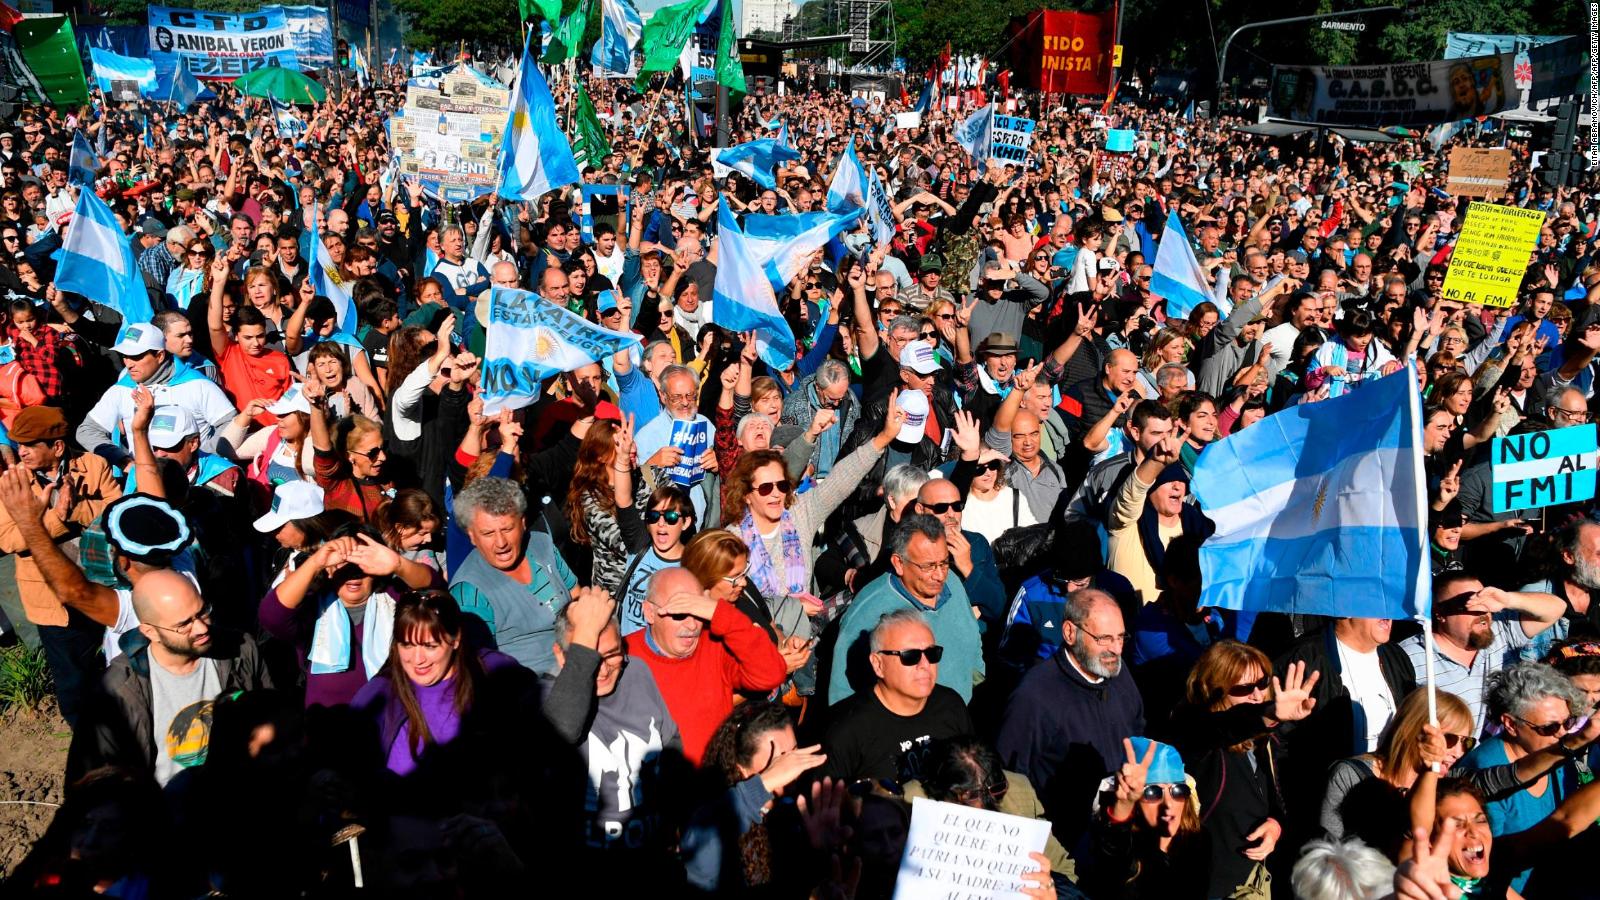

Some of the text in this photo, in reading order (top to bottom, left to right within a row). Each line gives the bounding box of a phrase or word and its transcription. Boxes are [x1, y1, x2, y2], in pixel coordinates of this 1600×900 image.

[1321, 21, 1366, 31] SARMIENTO
[177, 34, 238, 52] ANIBAL
[240, 34, 285, 52] VERON
[1014, 120, 1028, 132] SE
[1460, 154, 1506, 164] MACRI
[1469, 202, 1492, 213] BASTA
[1451, 257, 1462, 267] EN
[493, 290, 528, 311] LA
[1446, 288, 1508, 306] NO AL FMI
[485, 364, 520, 394] NO
[1500, 431, 1550, 464] NO
[1557, 454, 1586, 474] AL
[1505, 472, 1573, 510] FMI
[899, 740, 913, 753] YO
[942, 813, 1020, 837] EL QUE NO
[933, 830, 989, 851] QUIERE
[1006, 845, 1023, 857] SU
[909, 845, 959, 865] PATRIA
[965, 855, 985, 869] NO
[913, 866, 923, 877] A
[926, 868, 945, 881] SU
